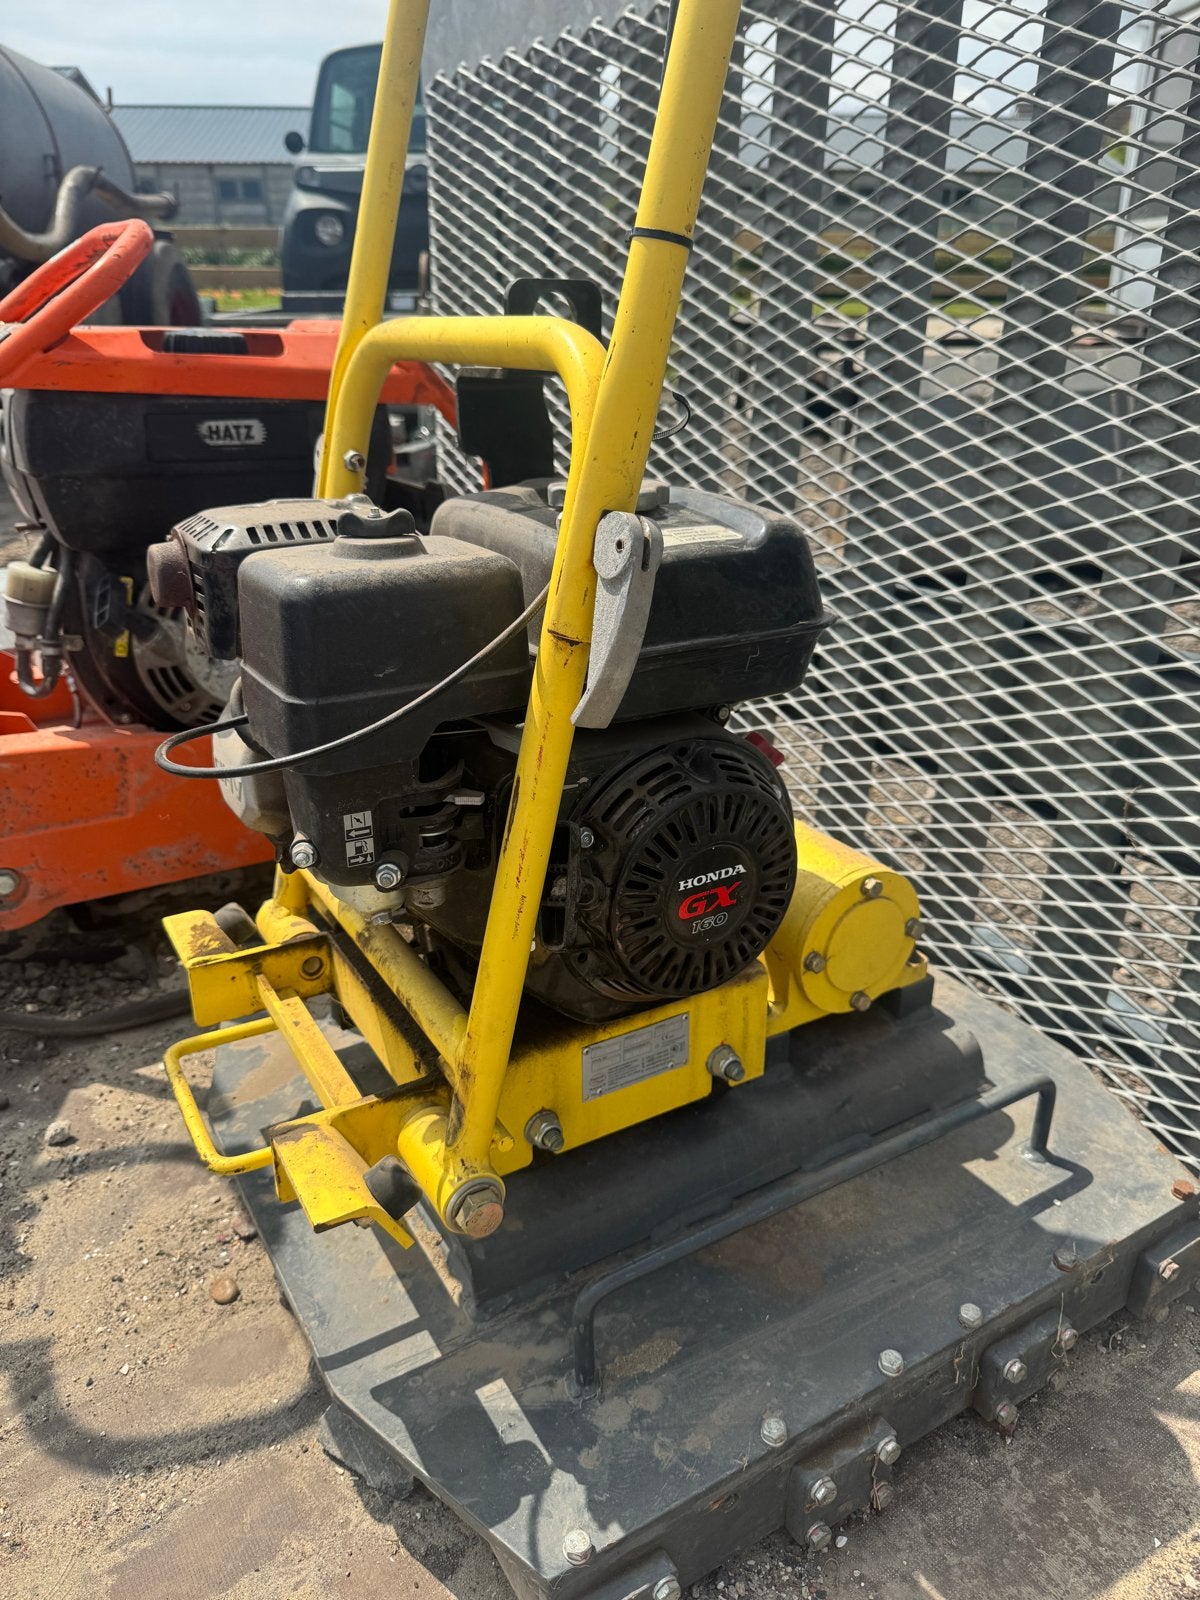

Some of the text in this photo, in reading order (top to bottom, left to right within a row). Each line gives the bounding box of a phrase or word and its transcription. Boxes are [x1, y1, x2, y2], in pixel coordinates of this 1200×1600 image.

[208, 424, 256, 441] HATZ
[678, 864, 747, 892] HONDA
[678, 881, 743, 920] GX
[692, 912, 729, 934] 160
